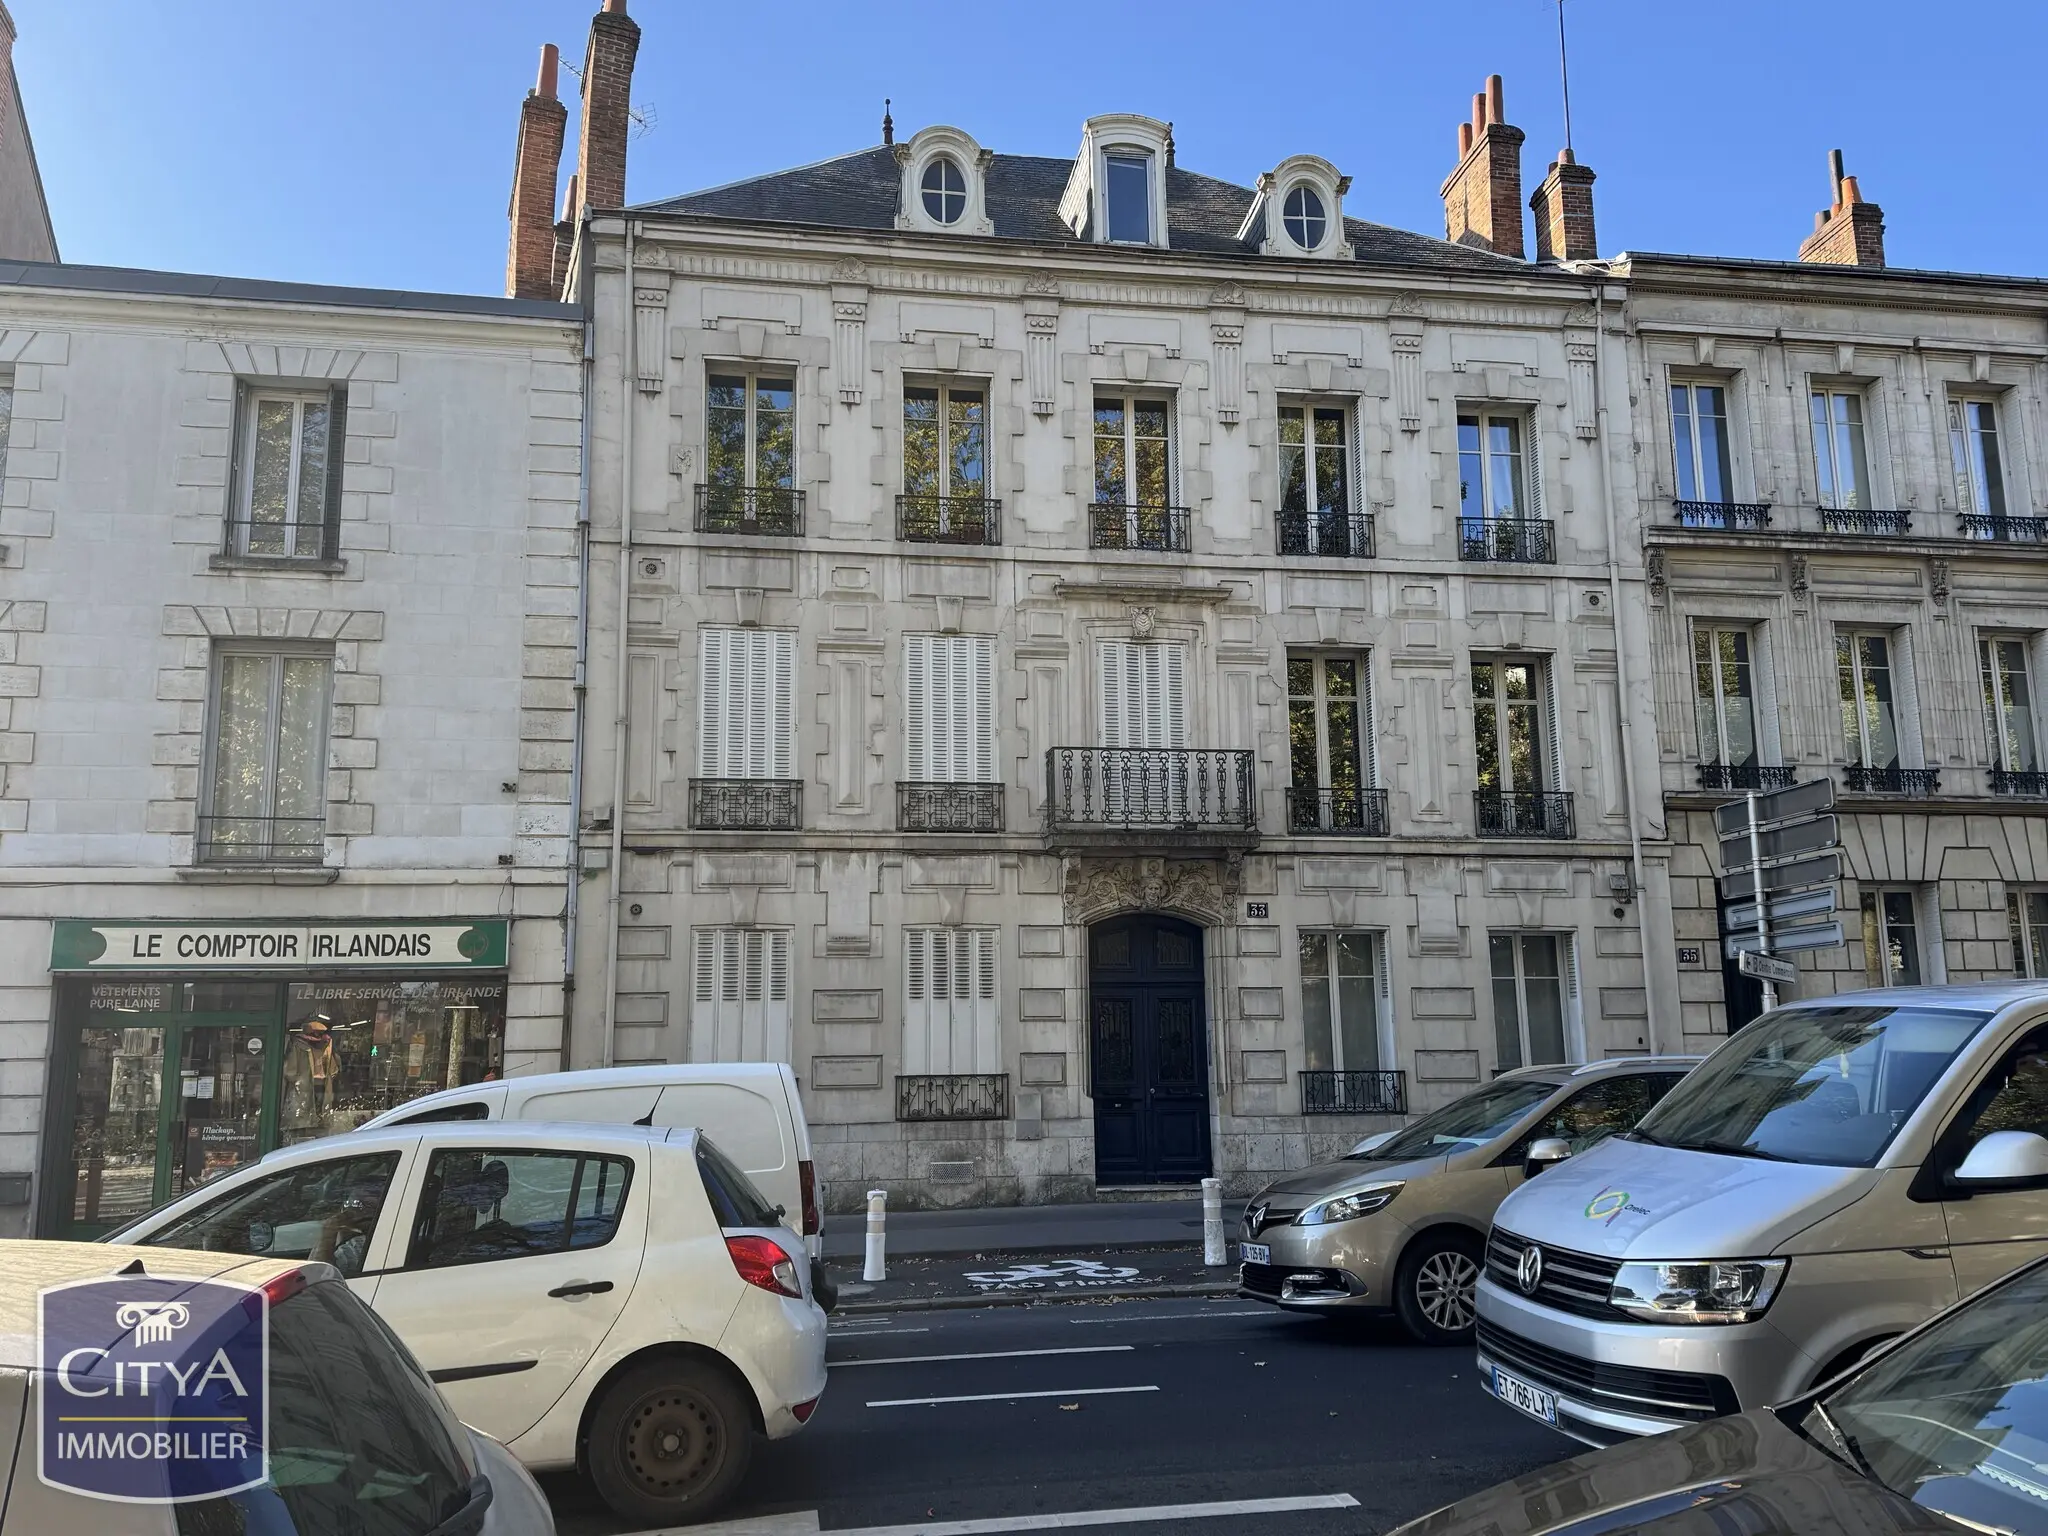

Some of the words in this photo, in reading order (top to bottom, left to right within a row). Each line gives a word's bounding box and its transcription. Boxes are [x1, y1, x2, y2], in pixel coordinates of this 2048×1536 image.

[1251, 904, 1265, 917] 33
[132, 934, 163, 958] LE
[177, 933, 298, 958] COMPTOIR
[312, 932, 432, 957] IRLANDAIS
[1682, 949, 1697, 962] 35
[411, 987, 430, 1000] DE
[432, 986, 502, 999] L'IRLANDE
[89, 999, 121, 1010] PURE
[124, 999, 161, 1009] LAINE
[1497, 1373, 1548, 1418] ET-766-LX
